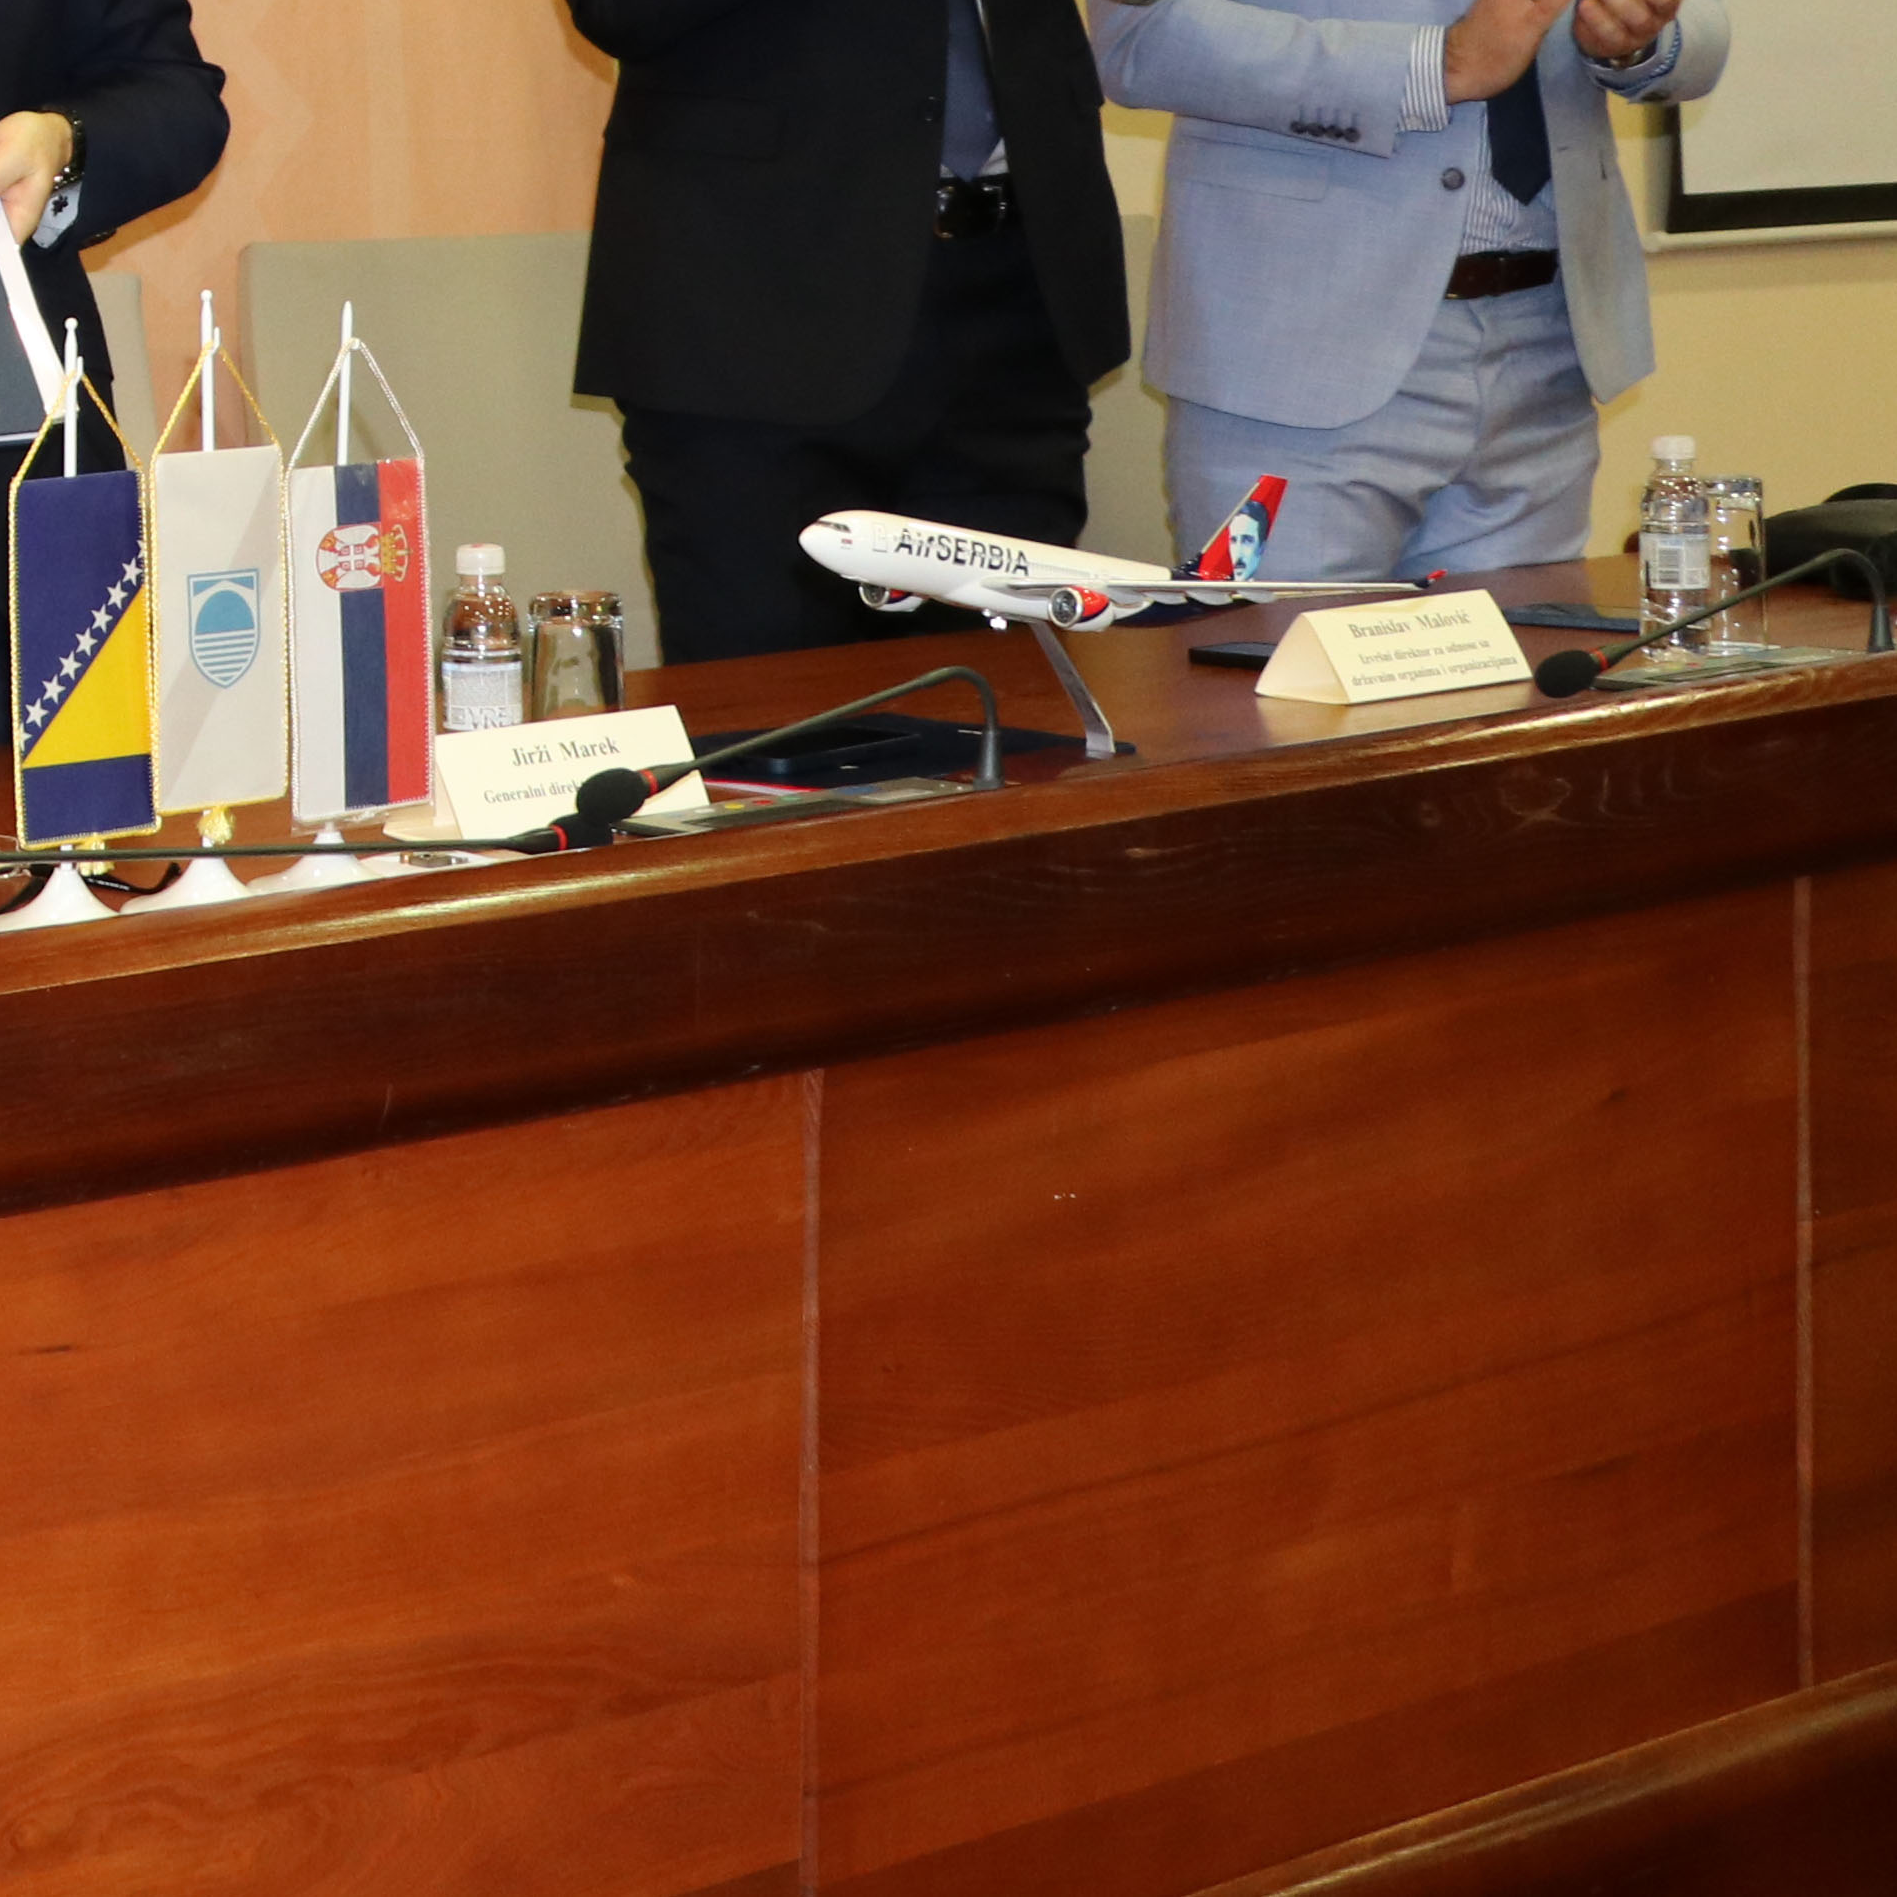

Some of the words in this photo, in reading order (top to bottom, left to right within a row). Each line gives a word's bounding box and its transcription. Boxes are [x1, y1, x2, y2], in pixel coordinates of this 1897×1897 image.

[894, 528, 1030, 576] AirSERBIA
[1348, 619, 1411, 638] Branislav
[512, 744, 552, 767] Jirži
[559, 737, 620, 762] Marek
[484, 783, 547, 804] Generalni
